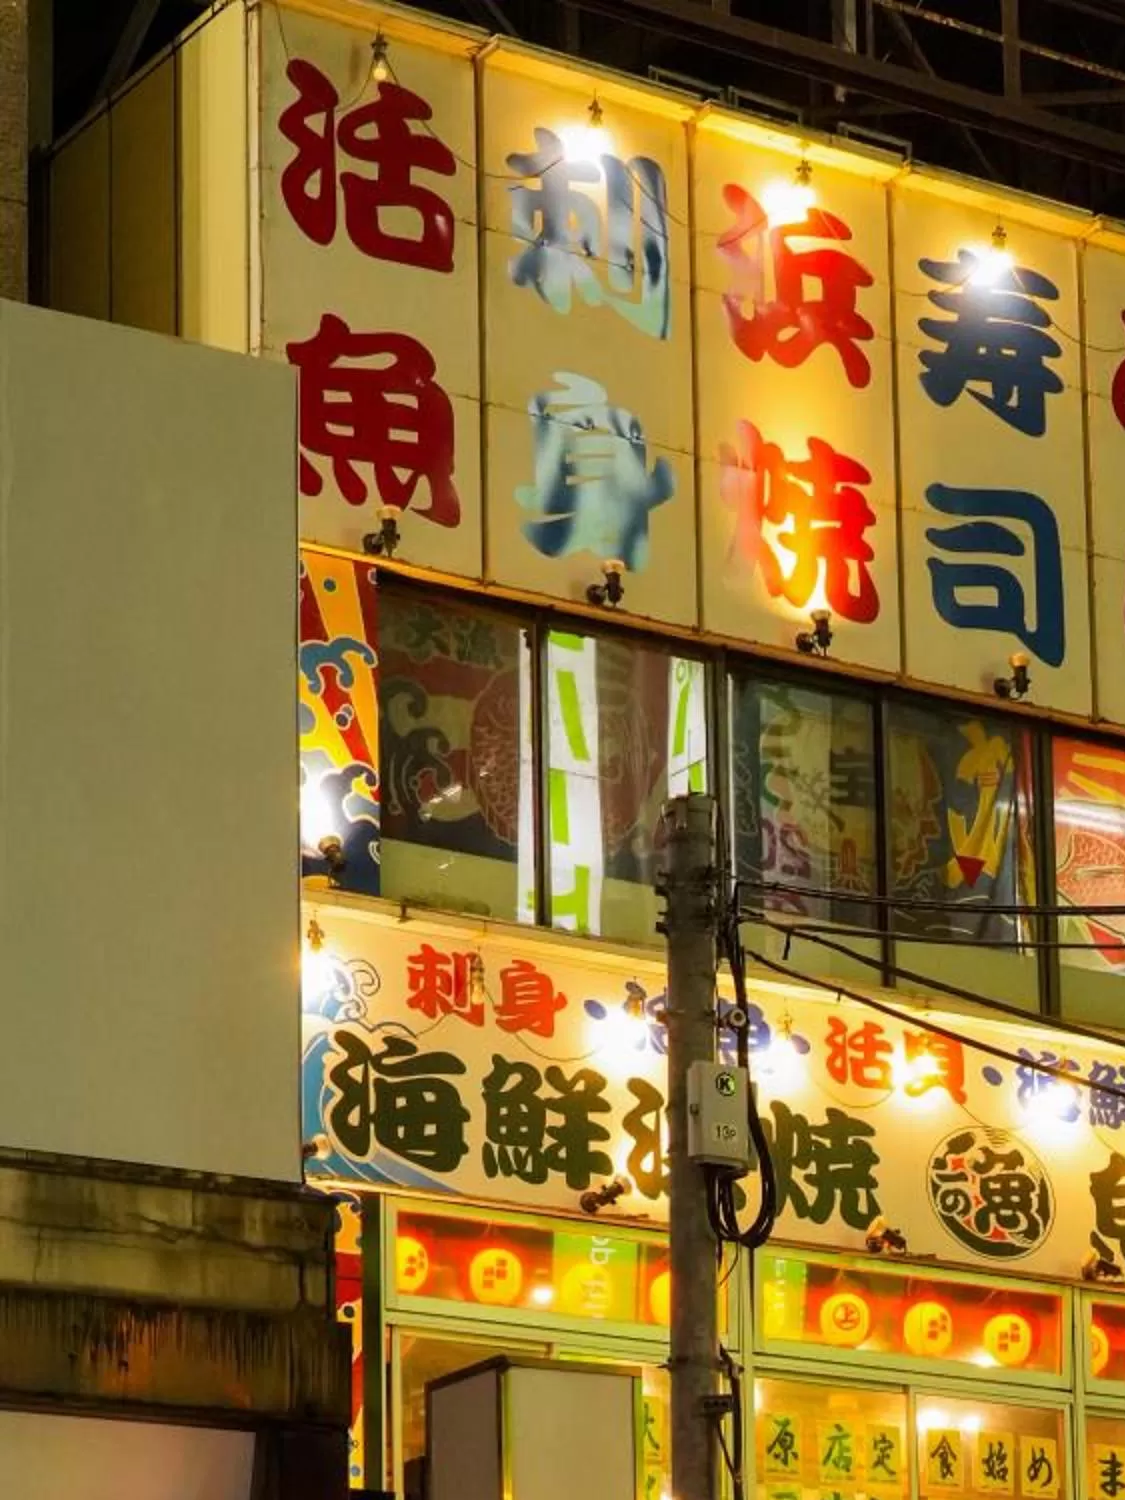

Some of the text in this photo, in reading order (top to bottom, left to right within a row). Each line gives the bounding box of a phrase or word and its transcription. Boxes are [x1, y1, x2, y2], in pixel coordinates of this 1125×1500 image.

[278, 57, 461, 529] 活魚
[505, 126, 676, 572] 刺身
[716, 182, 881, 624] 浜焼
[917, 249, 1066, 668] 寿司
